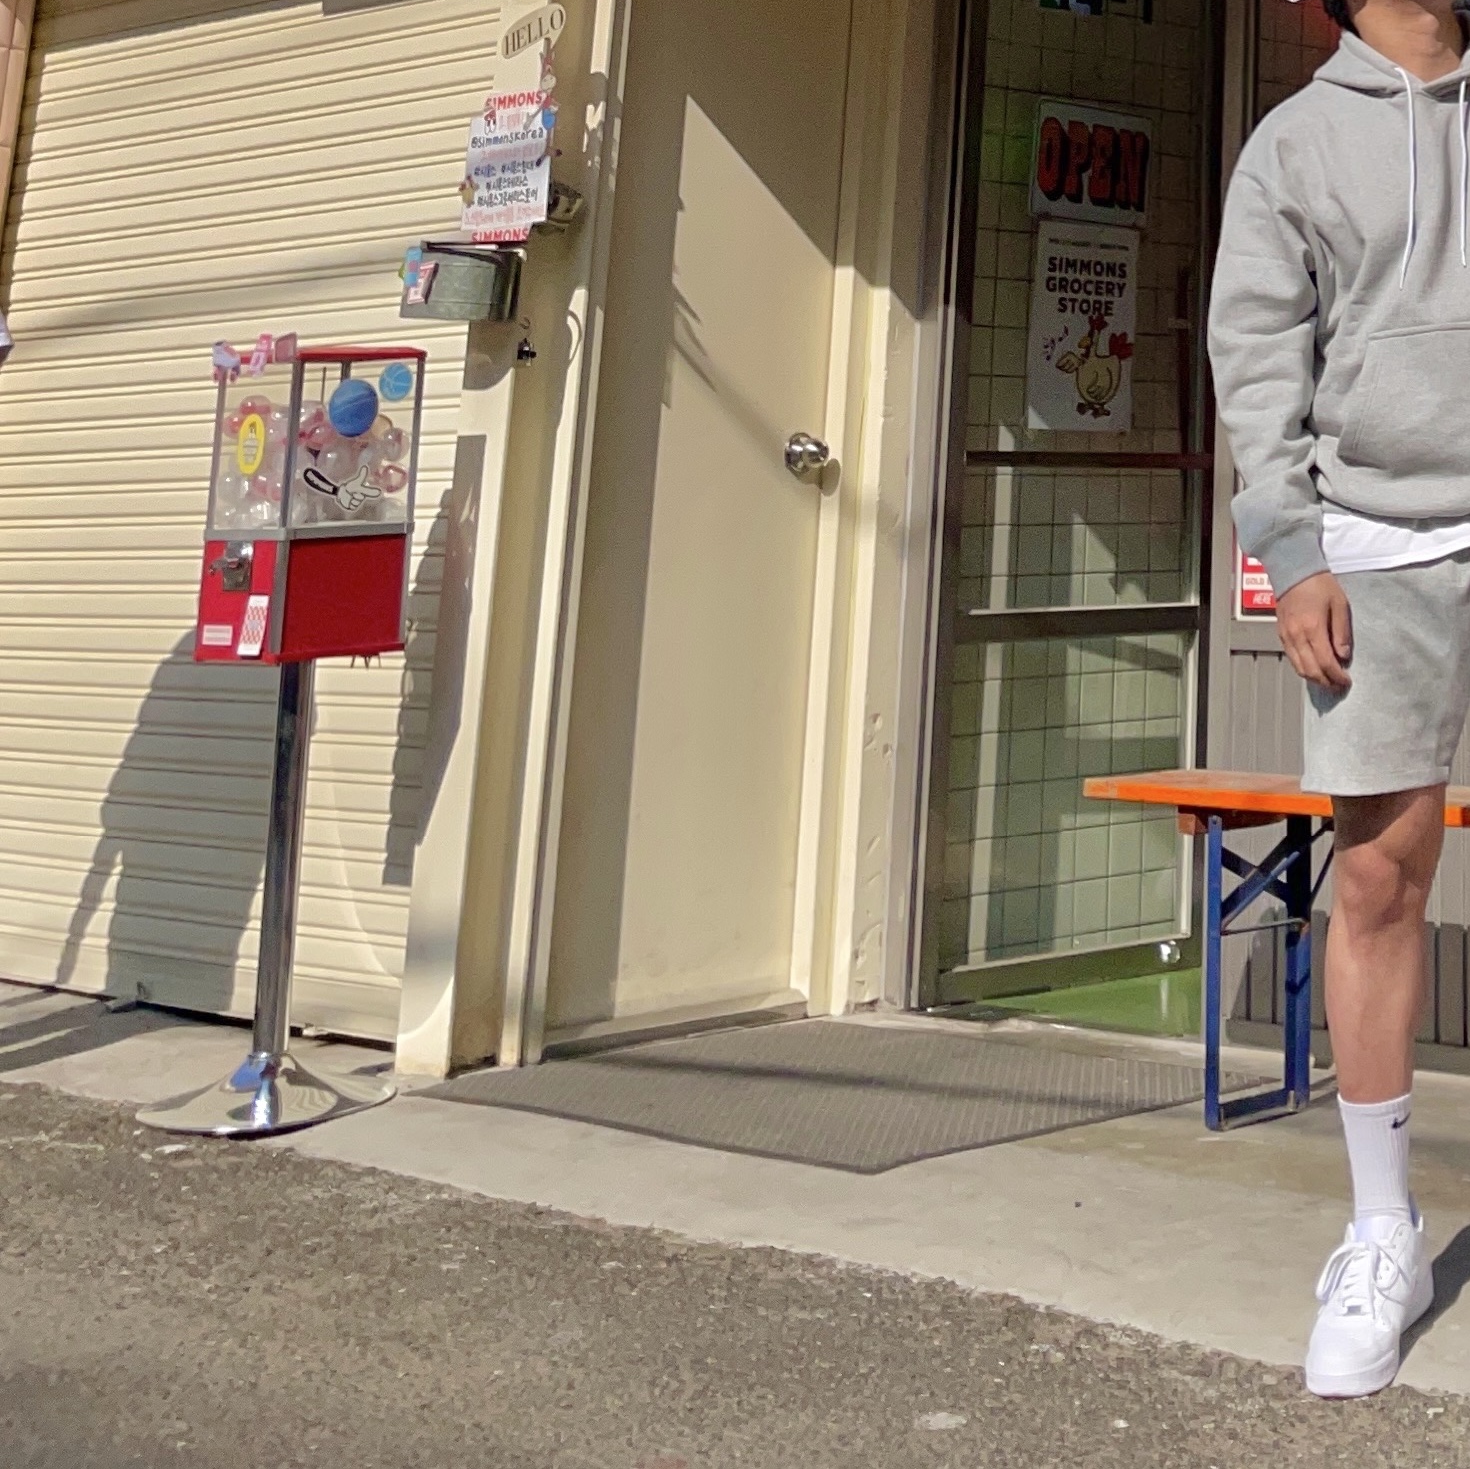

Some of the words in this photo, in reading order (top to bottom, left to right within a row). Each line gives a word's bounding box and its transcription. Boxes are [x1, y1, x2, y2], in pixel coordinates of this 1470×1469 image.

[504, 9, 564, 56] HELLO
[484, 91, 543, 110] SIMMONS
[1037, 116, 1149, 213] OPEN
[471, 227, 530, 243] SIMMONS
[1047, 256, 1128, 279] SIMMONS
[1045, 276, 1127, 298] GROCERY
[1057, 296, 1115, 317] STORE
